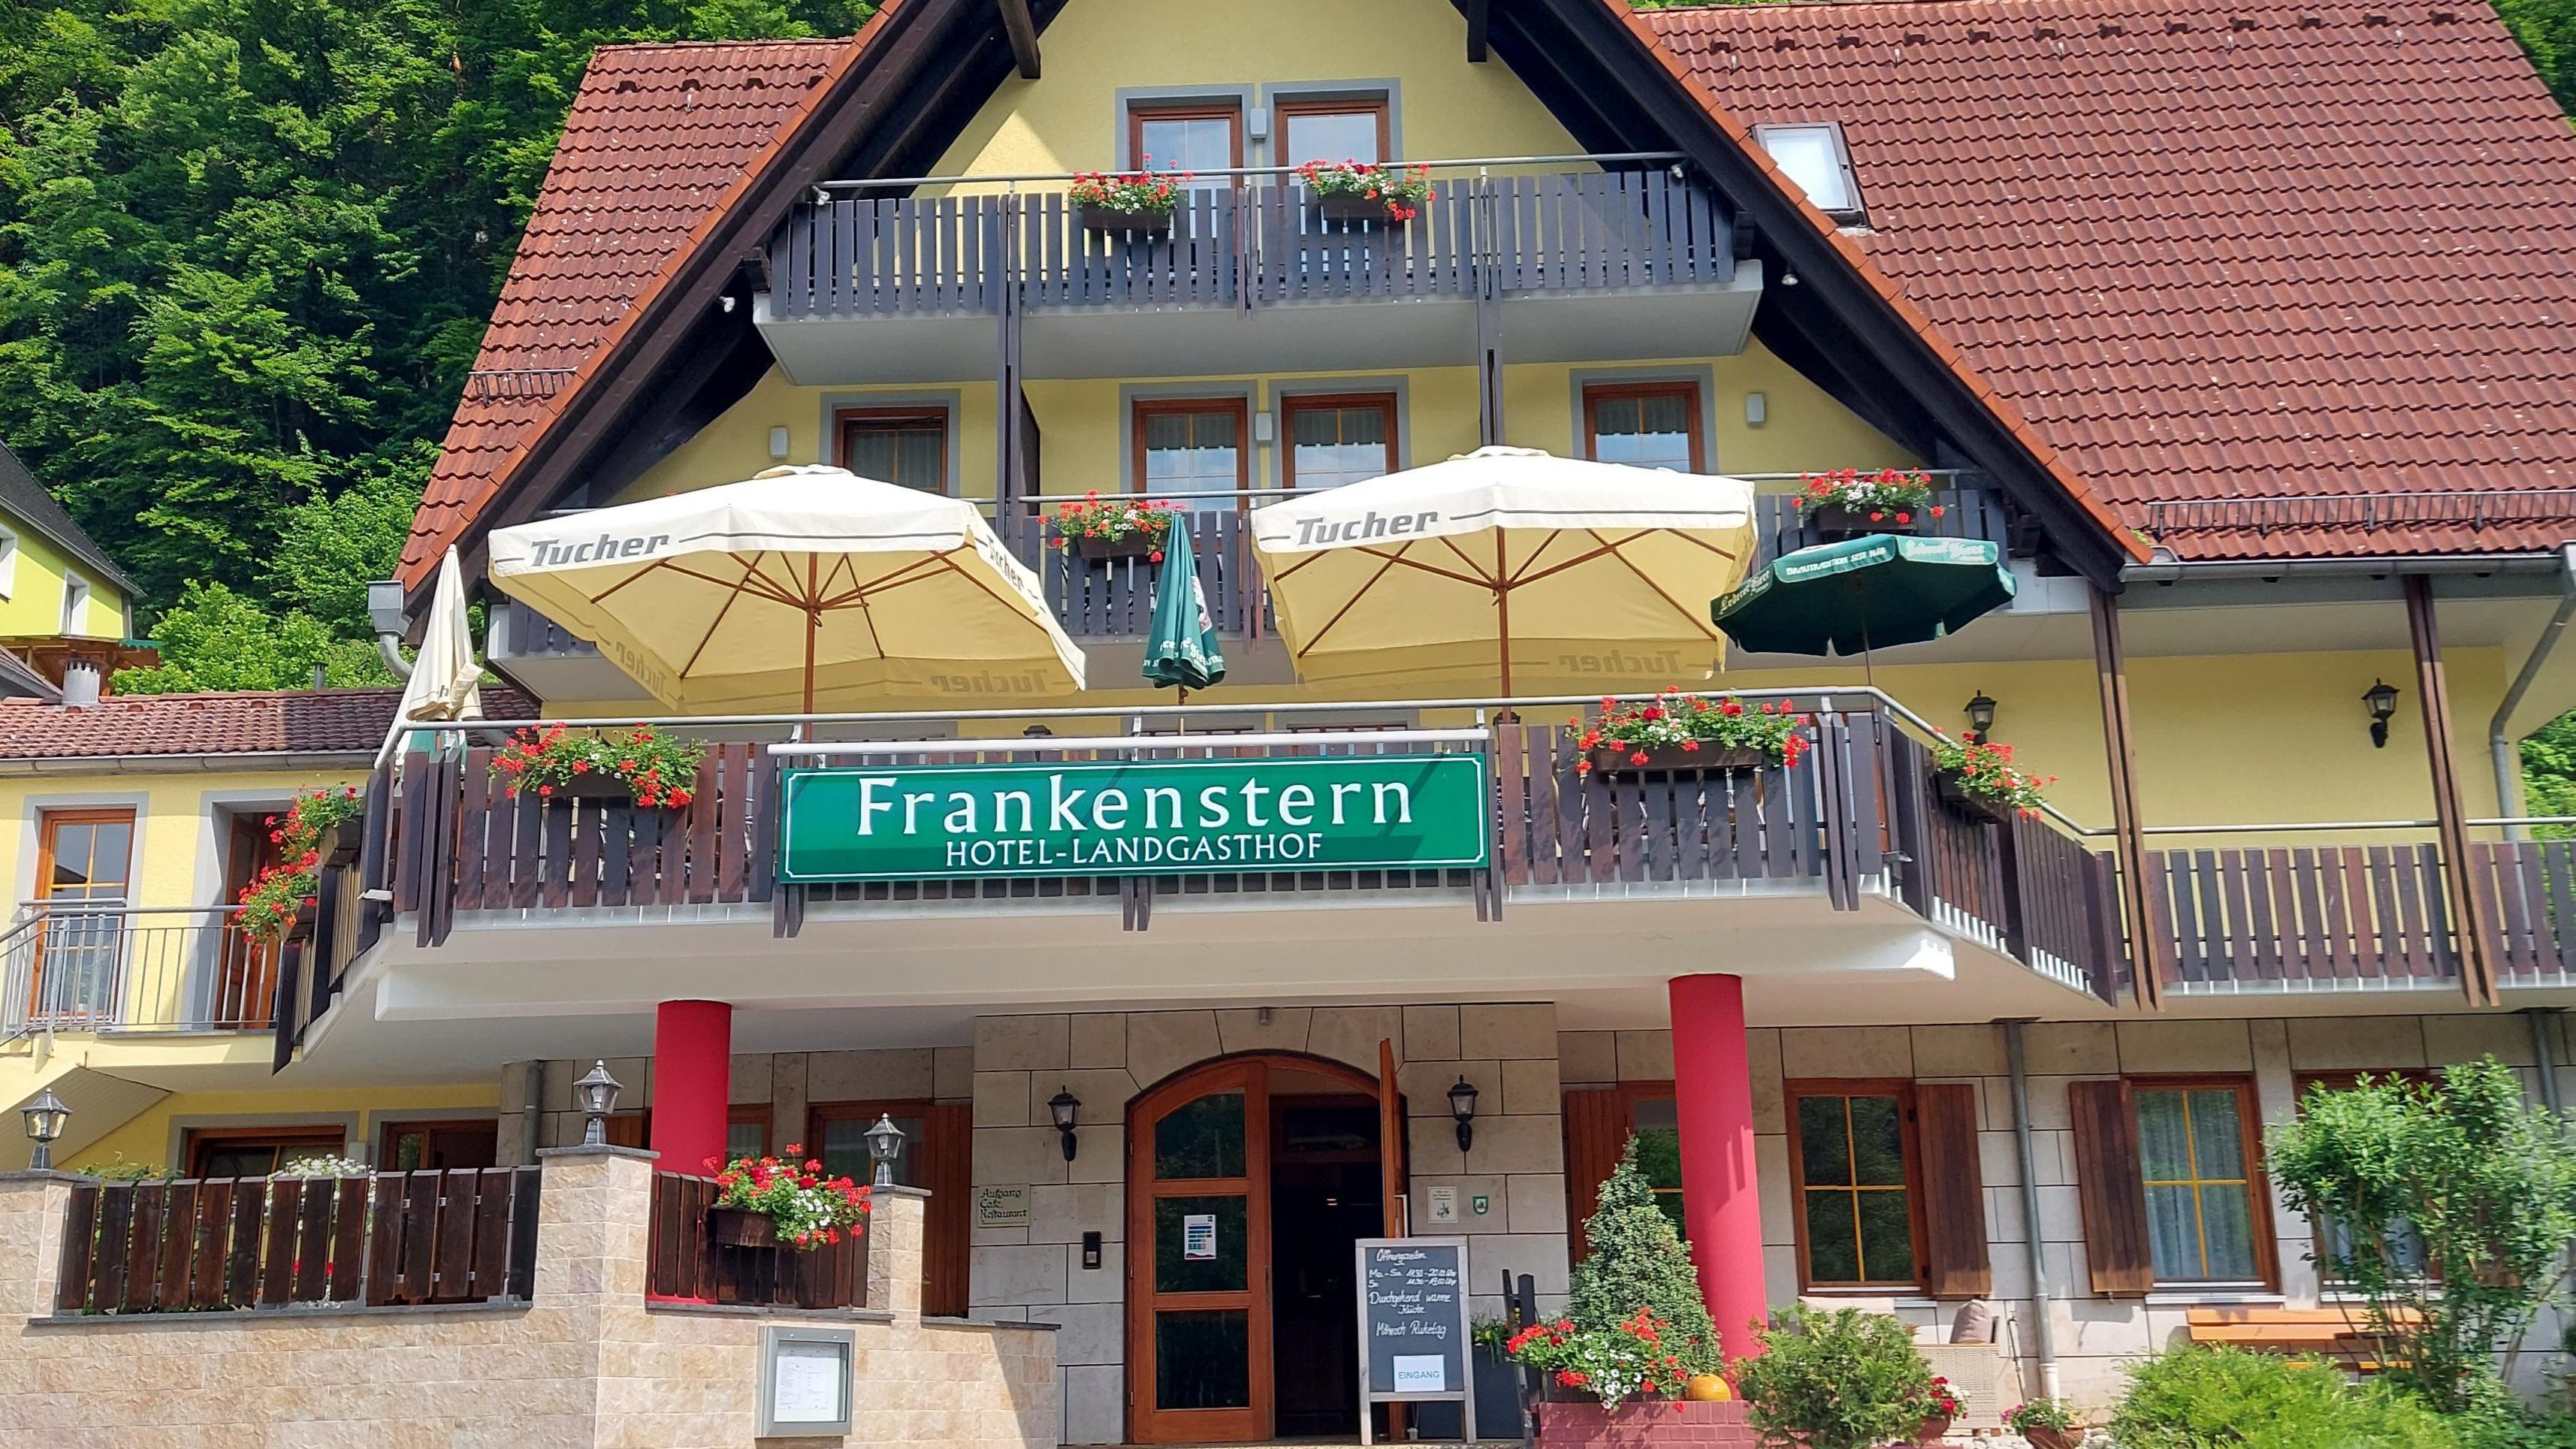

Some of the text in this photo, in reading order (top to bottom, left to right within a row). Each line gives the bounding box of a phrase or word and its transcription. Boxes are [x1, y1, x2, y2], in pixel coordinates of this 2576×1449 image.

[1295, 511, 1439, 546] Tucher
[530, 533, 670, 567] Tucher
[857, 774, 1414, 836] Frankenstern
[945, 833, 1323, 867] HOTEL-LANDGASTHOF
[1398, 1371, 1440, 1380] EINGANG
